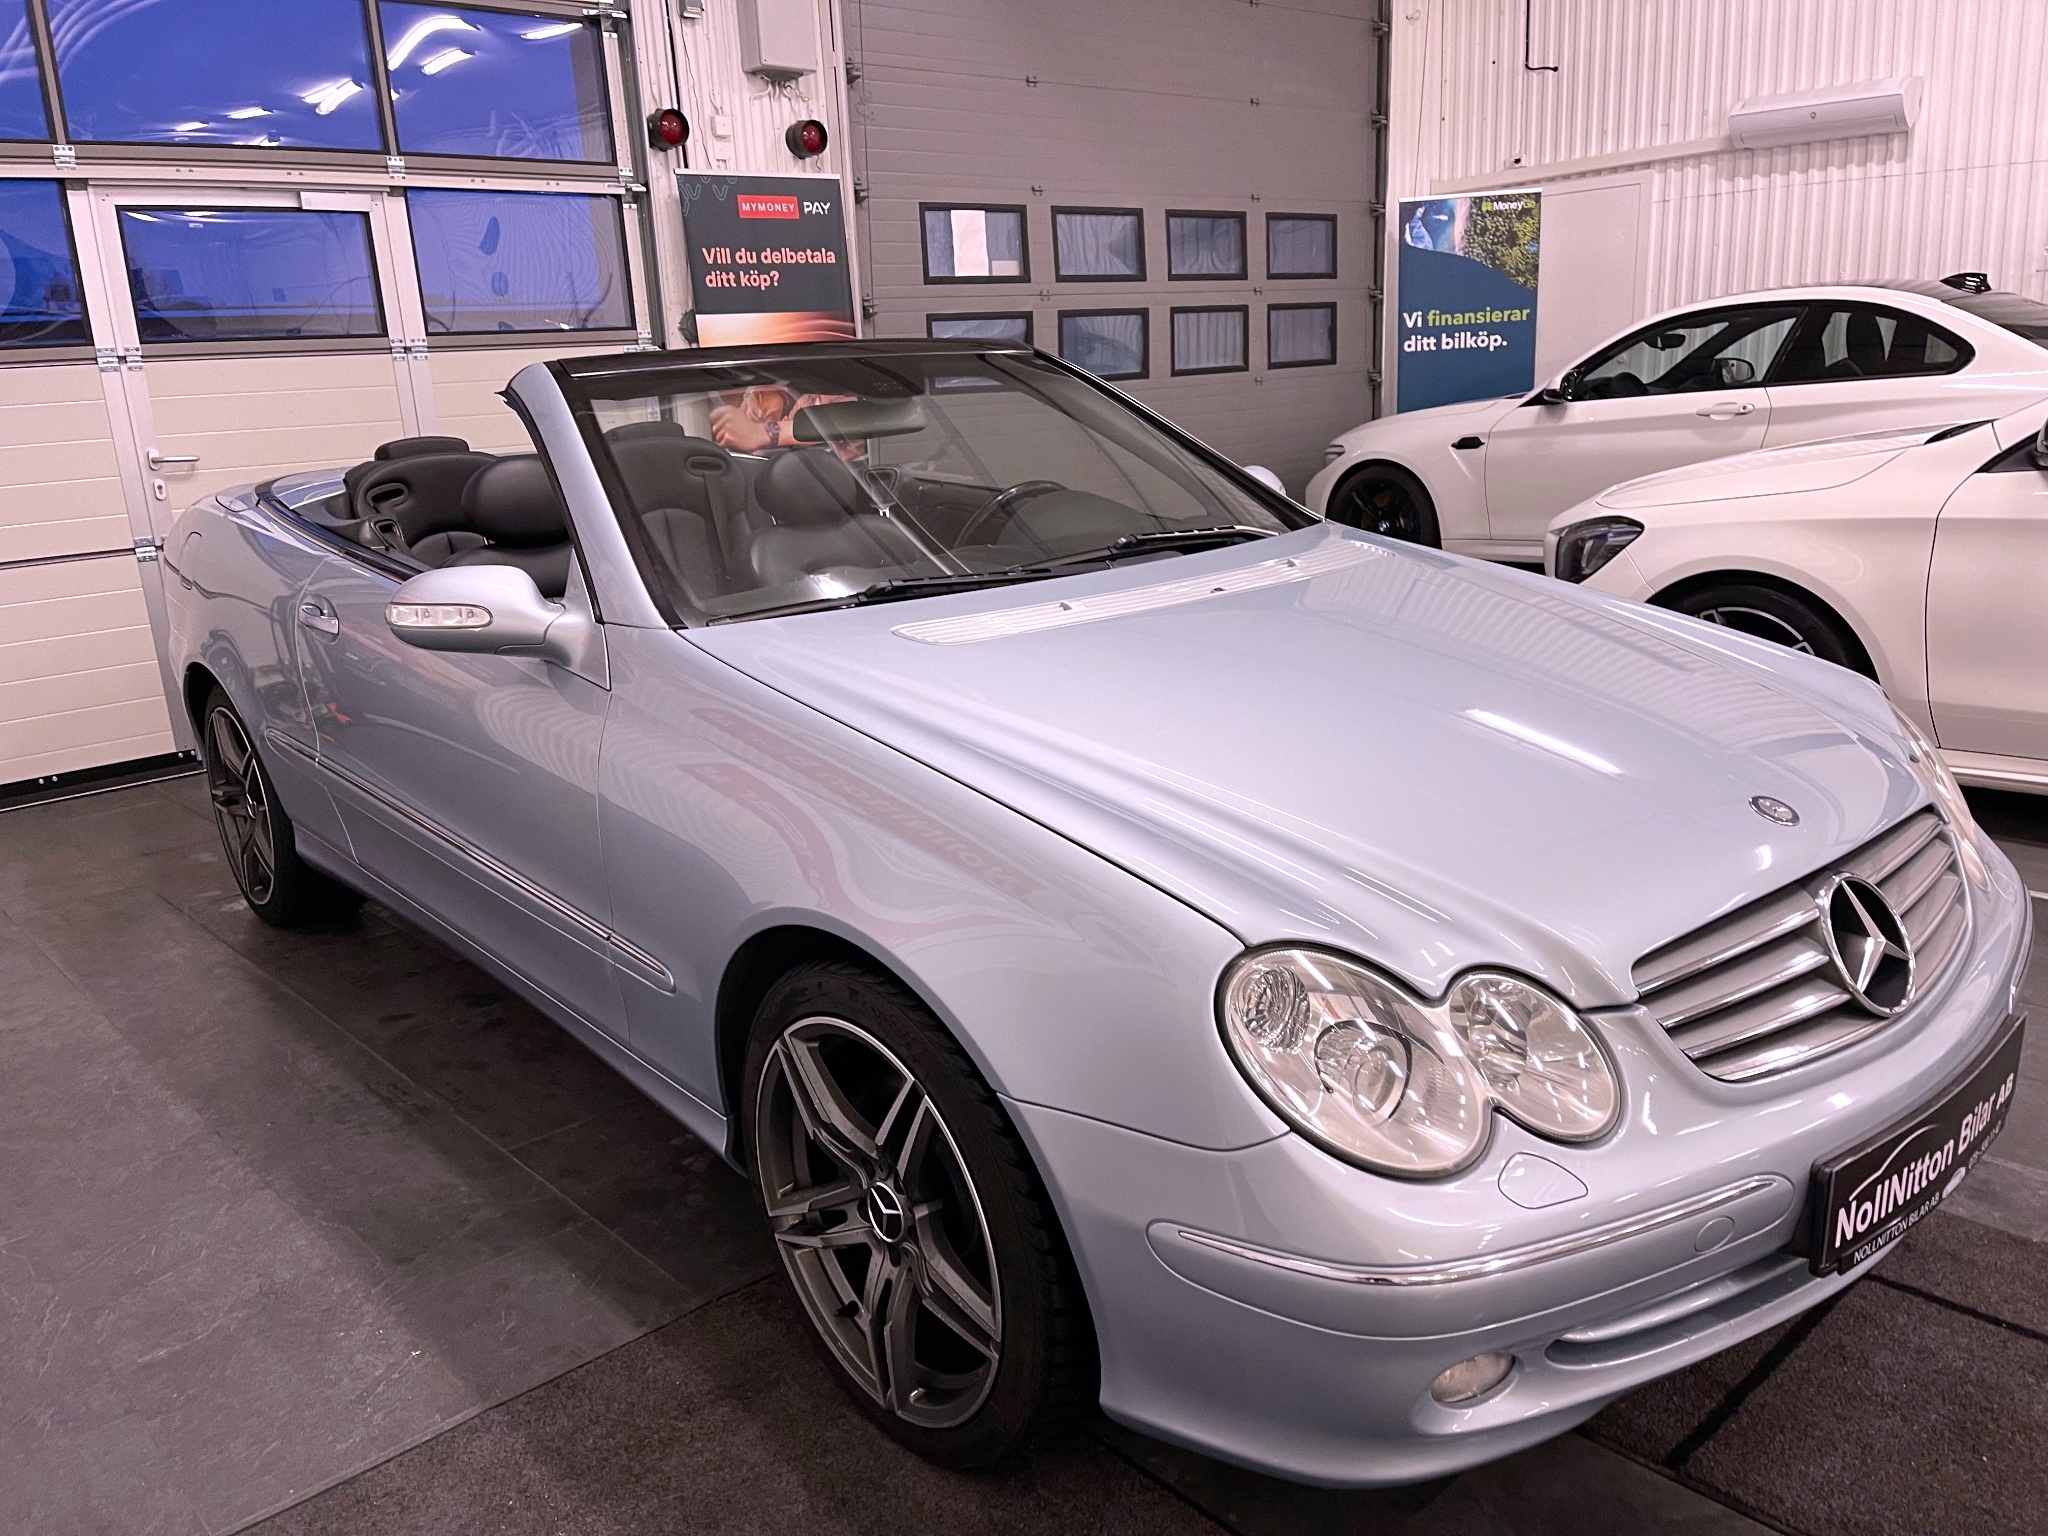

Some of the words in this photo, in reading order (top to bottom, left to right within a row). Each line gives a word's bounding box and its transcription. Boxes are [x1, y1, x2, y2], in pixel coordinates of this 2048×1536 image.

[741, 202, 795, 212] MYMONEY
[803, 201, 831, 214] PAY
[702, 248, 732, 264] Vill
[735, 248, 757, 264] du
[760, 248, 836, 264] delbetala
[705, 272, 737, 288] ditt
[740, 270, 780, 290] köp?
[1403, 312, 1423, 328] Vi
[1427, 307, 1530, 326] finansierar
[1403, 335, 1437, 352] ditt
[1441, 331, 1508, 351] bilköp.
[1835, 1138, 1955, 1249] NollNitton
[1957, 1092, 1996, 1155] Bilar
[1996, 1072, 2014, 1110] AB
